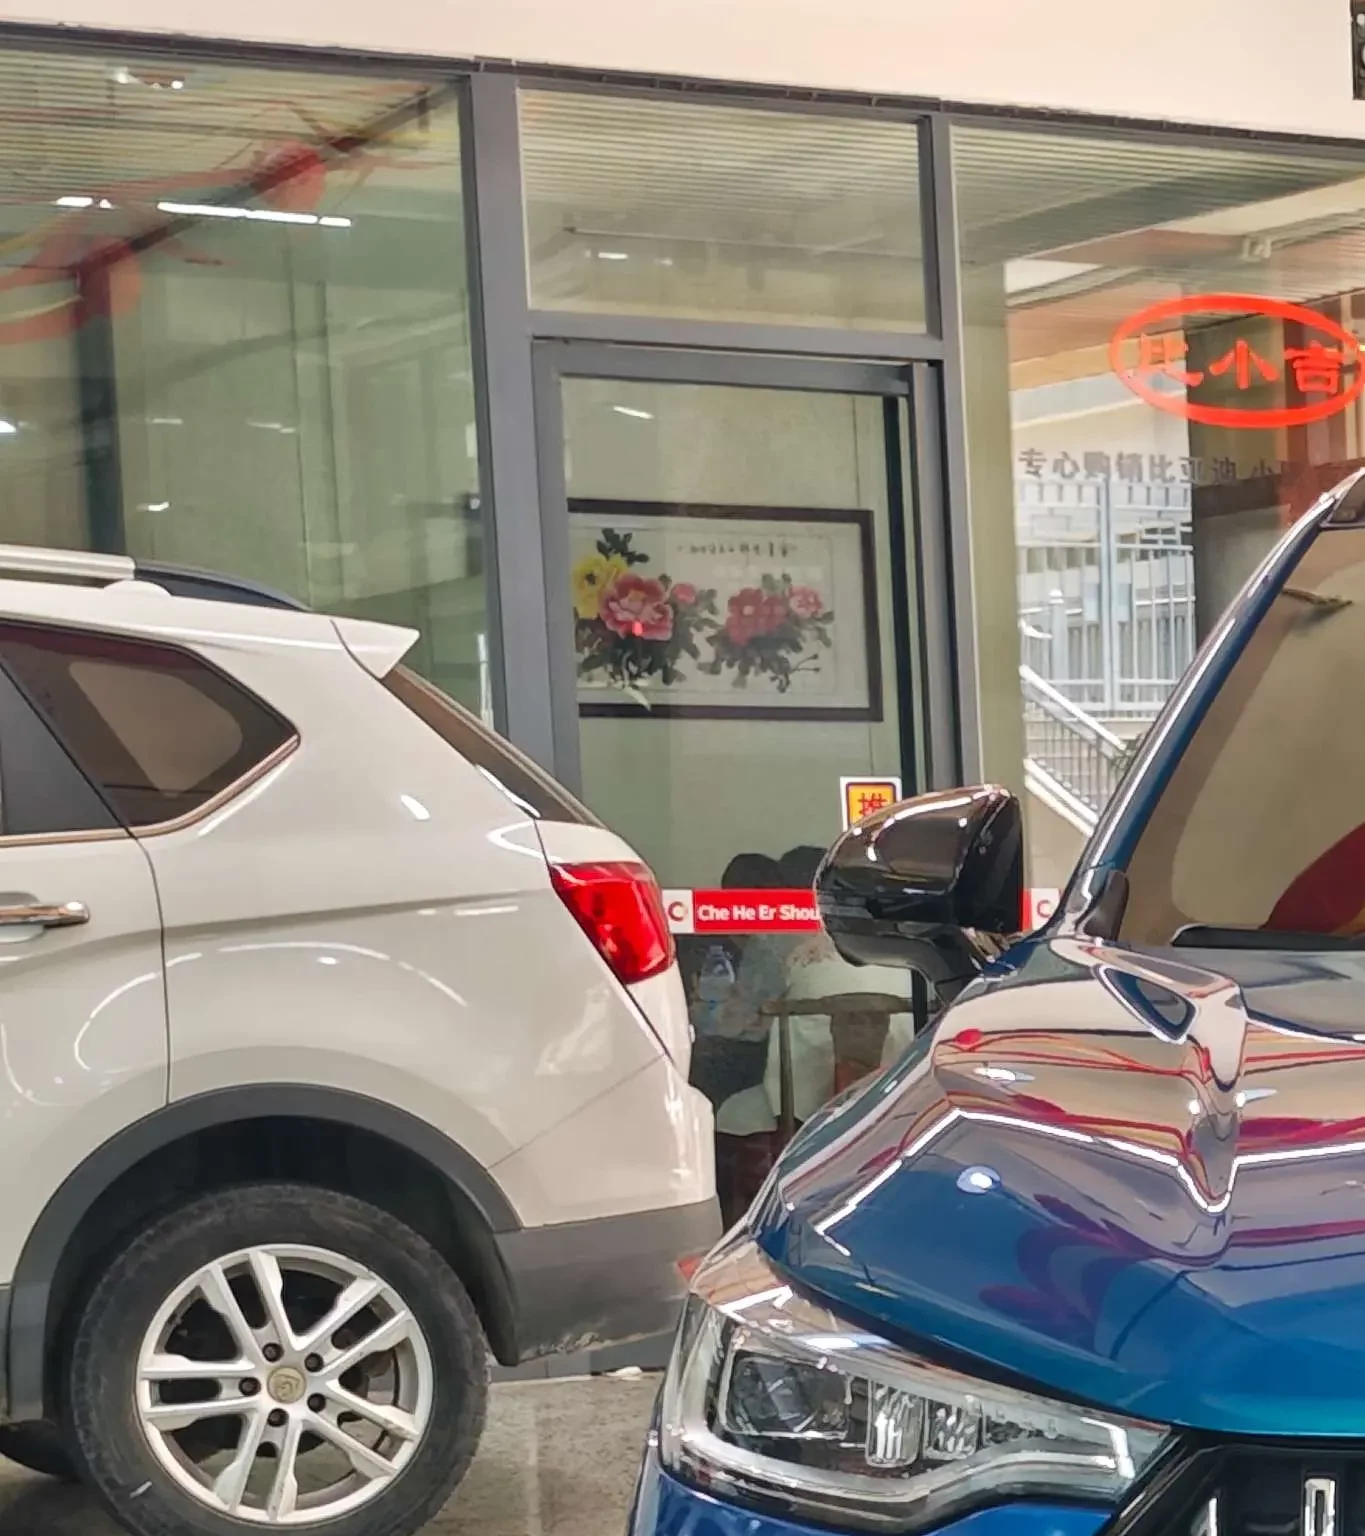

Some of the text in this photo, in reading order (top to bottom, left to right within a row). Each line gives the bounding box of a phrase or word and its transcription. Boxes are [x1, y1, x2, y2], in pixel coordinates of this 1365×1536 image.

[697, 904, 822, 921] Che He Er Shou
